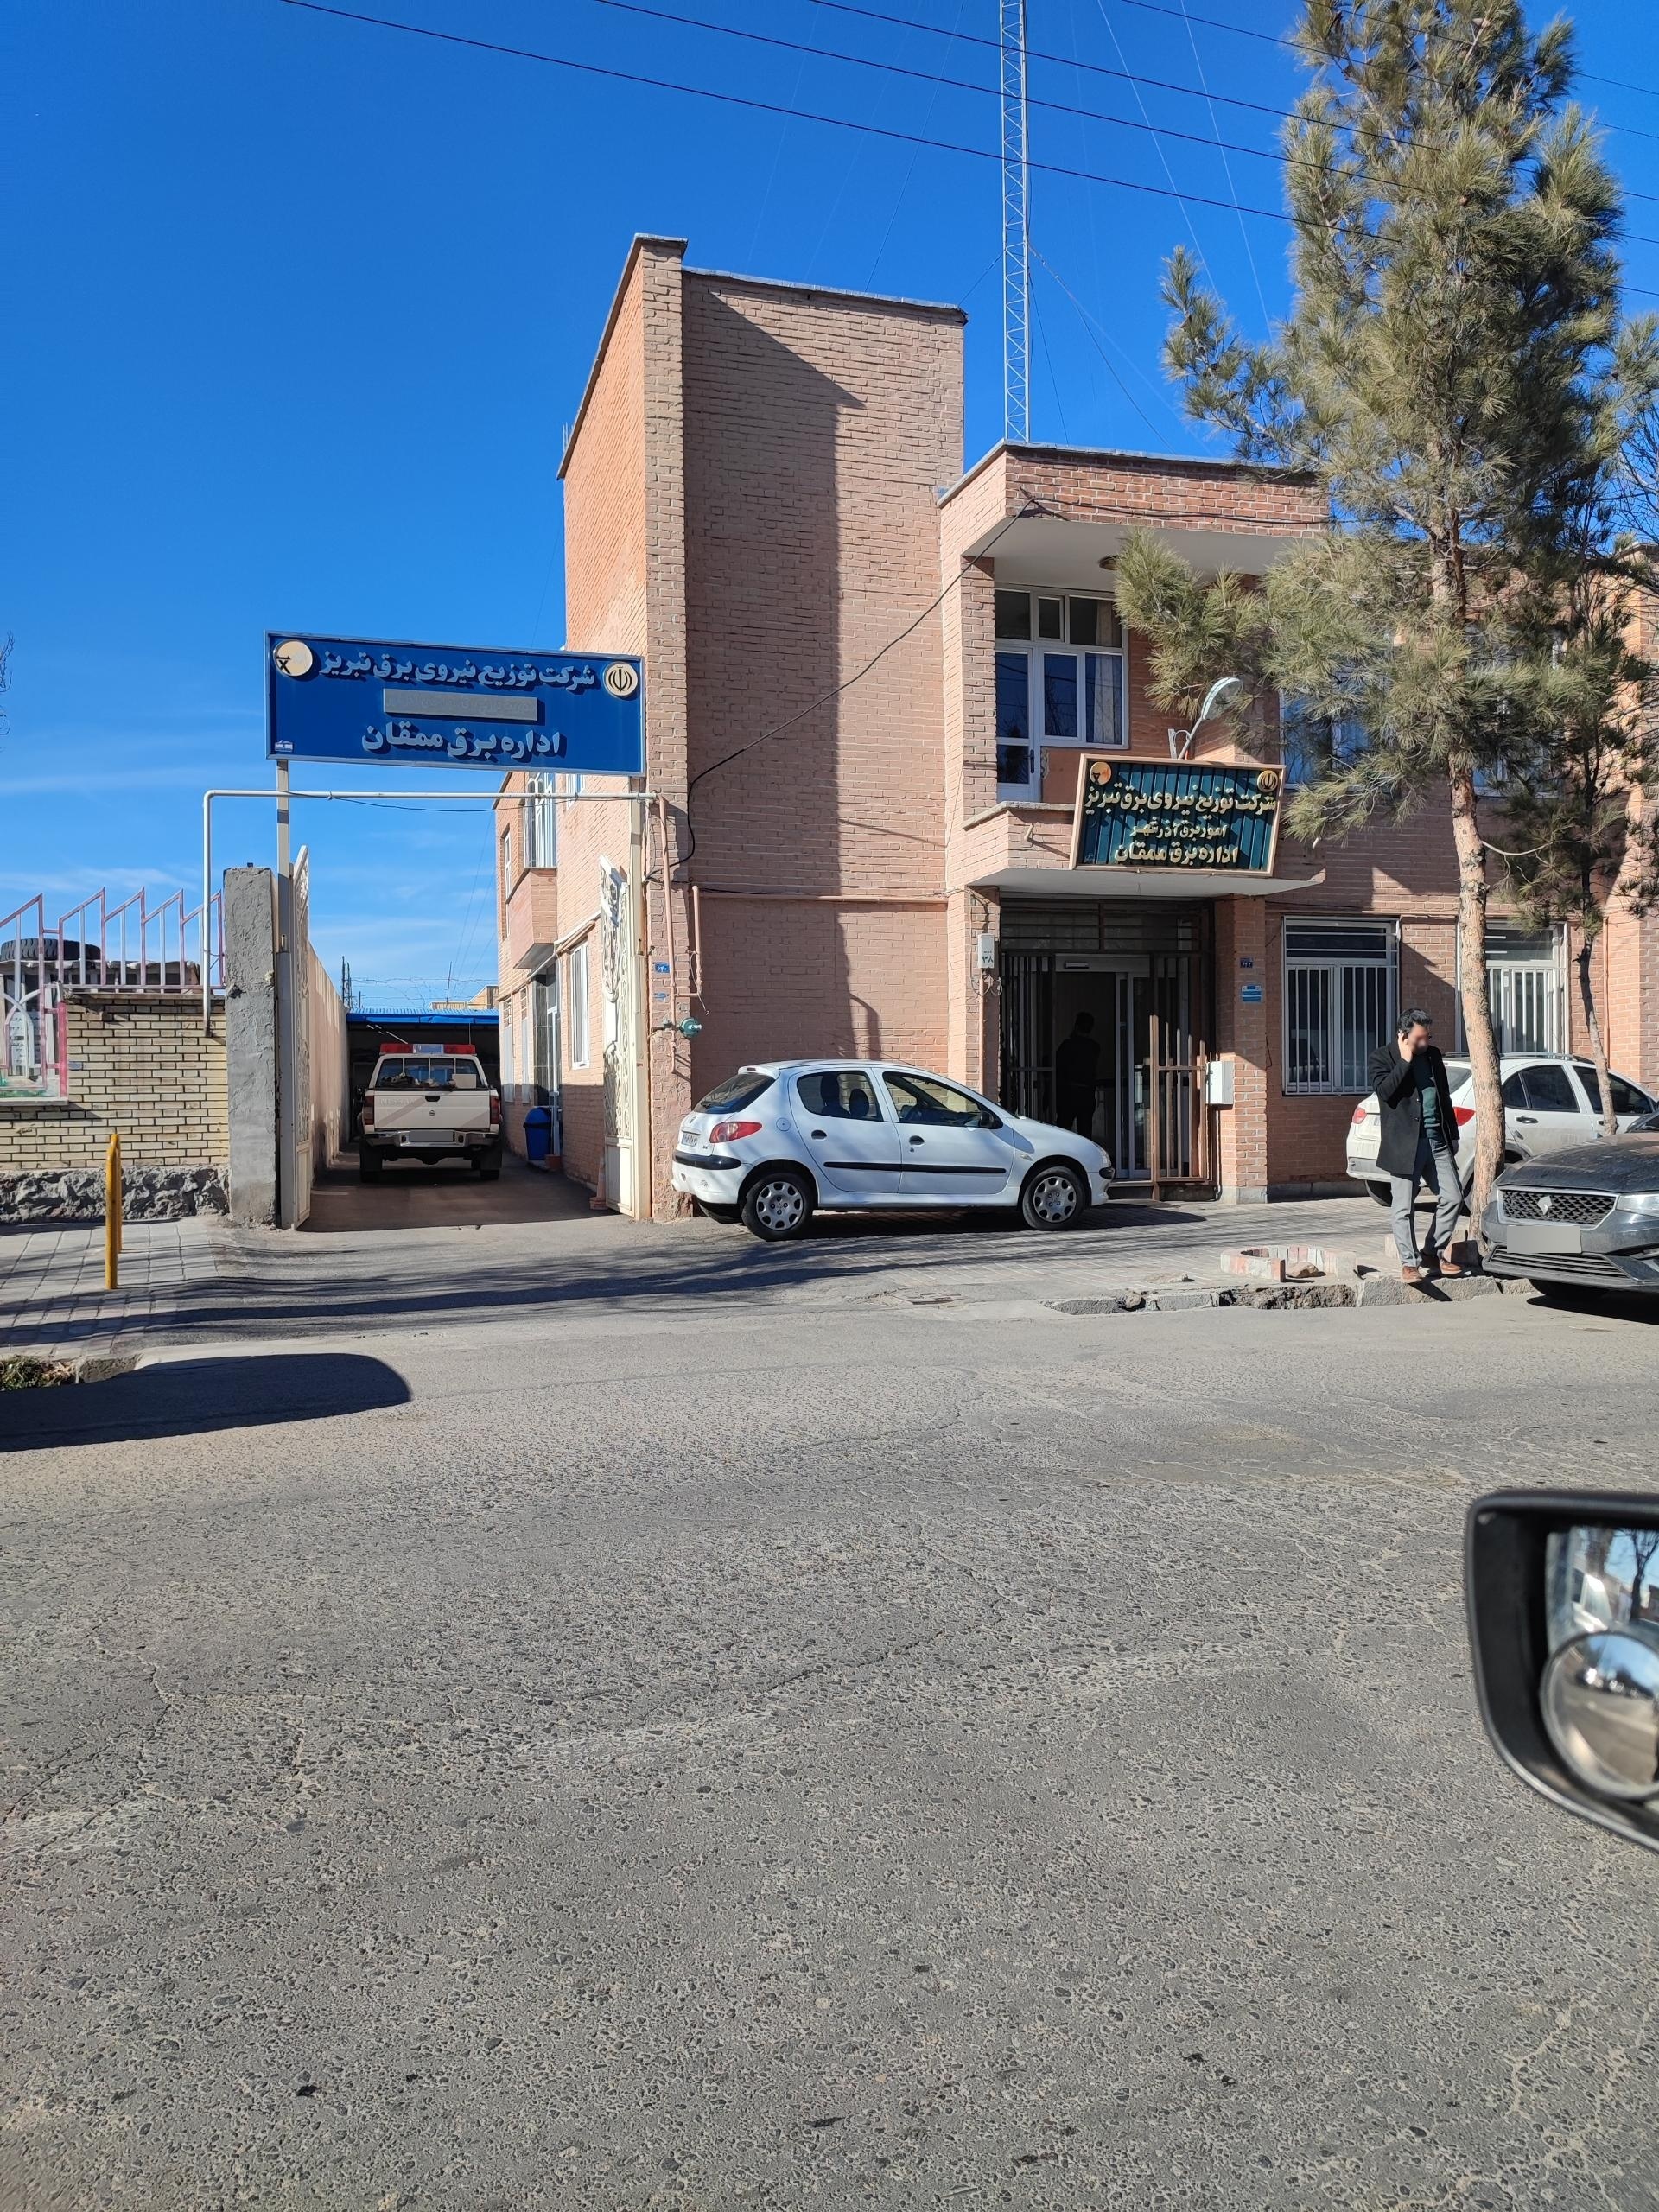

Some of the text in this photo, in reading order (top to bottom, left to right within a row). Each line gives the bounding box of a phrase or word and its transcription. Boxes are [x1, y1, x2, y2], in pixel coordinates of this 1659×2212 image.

[319, 651, 595, 690] شرکت توزیع نیروی برق تبریز
[361, 721, 560, 760] اداره برق ممقان
[1084, 782, 1276, 819] شرکت توزیع نیروی برق تبریز
[1179, 820, 1201, 841] برق
[1199, 824, 1228, 839] امور
[1114, 842, 1167, 862] ممقان
[1170, 842, 1198, 865] برق
[1199, 846, 1238, 863] اداره
